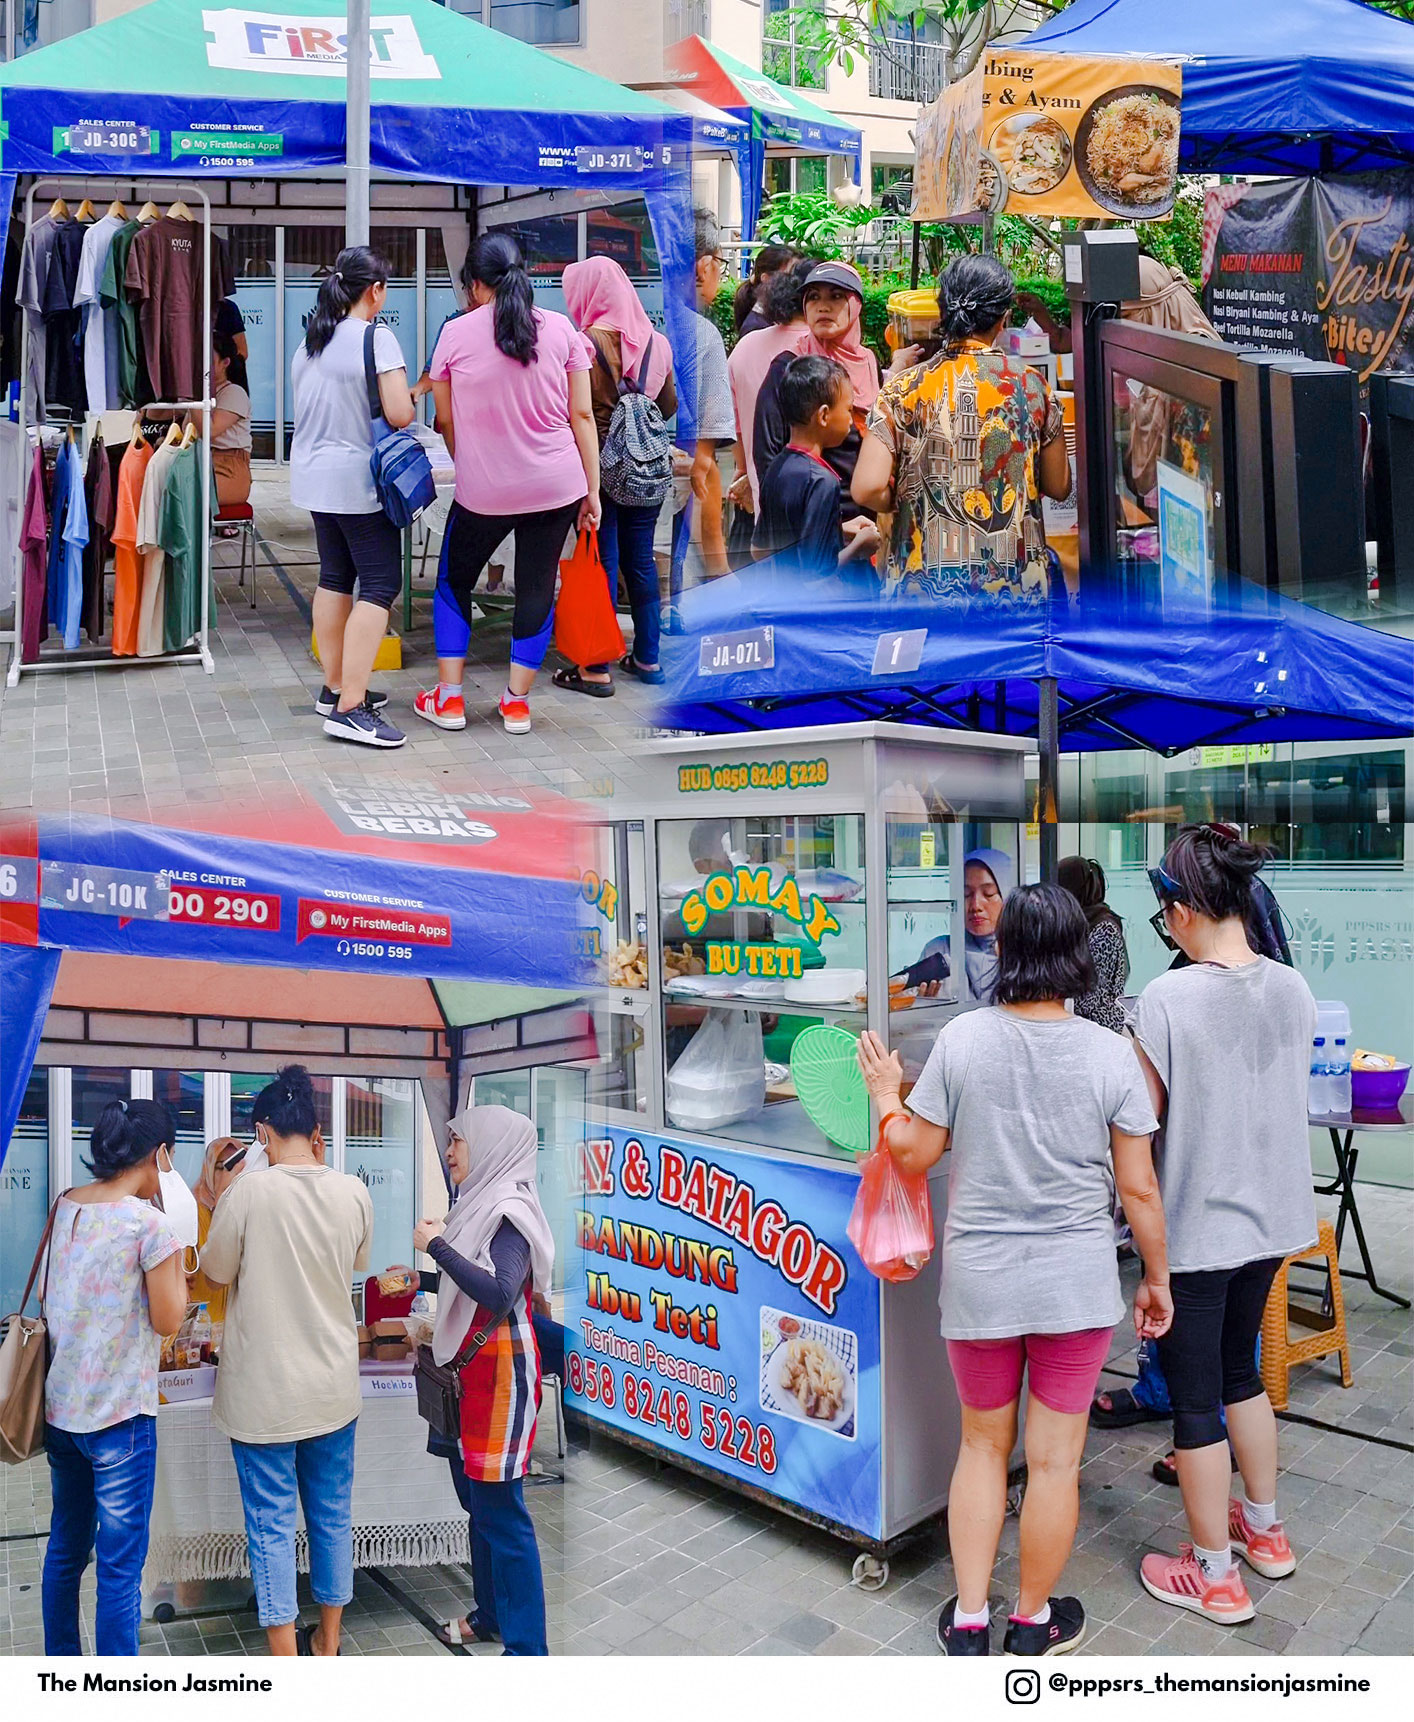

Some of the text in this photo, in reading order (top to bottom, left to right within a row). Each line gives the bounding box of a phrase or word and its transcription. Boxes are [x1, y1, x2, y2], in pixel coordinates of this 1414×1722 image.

[306, 53, 342, 61] MEDIA
[999, 87, 1017, 106] &
[1024, 89, 1081, 112] Ayam
[78, 118, 136, 128] SALES CENTER
[190, 122, 264, 132] CUSTOMER SERVICE
[83, 132, 138, 148] JD-30C
[194, 140, 280, 151] My FirstMedia Apps
[210, 158, 254, 166] 1500 595
[588, 153, 633, 168] JD-37L
[661, 147, 672, 165] 5
[171, 238, 193, 249] KYUTA
[1220, 253, 1304, 274] MENU MAKANAN
[1213, 288, 1286, 305] Nasi Kebuli Kambing
[1315, 195, 1414, 383] Tasty
[1213, 305, 1225, 316] Nasi
[1226, 306, 1250, 320] Biryani
[1252, 308, 1289, 324] Kambing
[1290, 310, 1299, 322] &
[1213, 322, 1294, 341] Beef Tortilla Mozarella
[1327, 315, 1386, 355] Bites
[712, 640, 762, 667] JA-07L
[890, 636, 903, 665] 1
[679, 758, 828, 793] HUB 0858 8248 5228
[335, 800, 468, 819] LEBIH
[348, 814, 499, 838] BEBAS
[0, 864, 17, 897] 6
[159, 868, 247, 888] SALES CENTER
[66, 877, 148, 910] JC-10K
[324, 889, 425, 909] CUSTOMER SERVICE
[213, 896, 269, 924] 290
[680, 865, 841, 946] SOMAY
[330, 914, 448, 938] My FirstMedia Apps
[1345, 920, 1391, 932] PPPSRS
[352, 943, 413, 959] 1500 595
[706, 942, 803, 978] BU TETI
[620, 1140, 652, 1197] &
[657, 1143, 847, 1316] BATAGOR
[574, 1208, 739, 1294] BANDUNG
[585, 1270, 721, 1350] Ibu Teti
[580, 1318, 641, 1364] Terima
[644, 1339, 726, 1398] Pesanan
[621, 1370, 693, 1440] 8248
[699, 1401, 778, 1475] 5228
